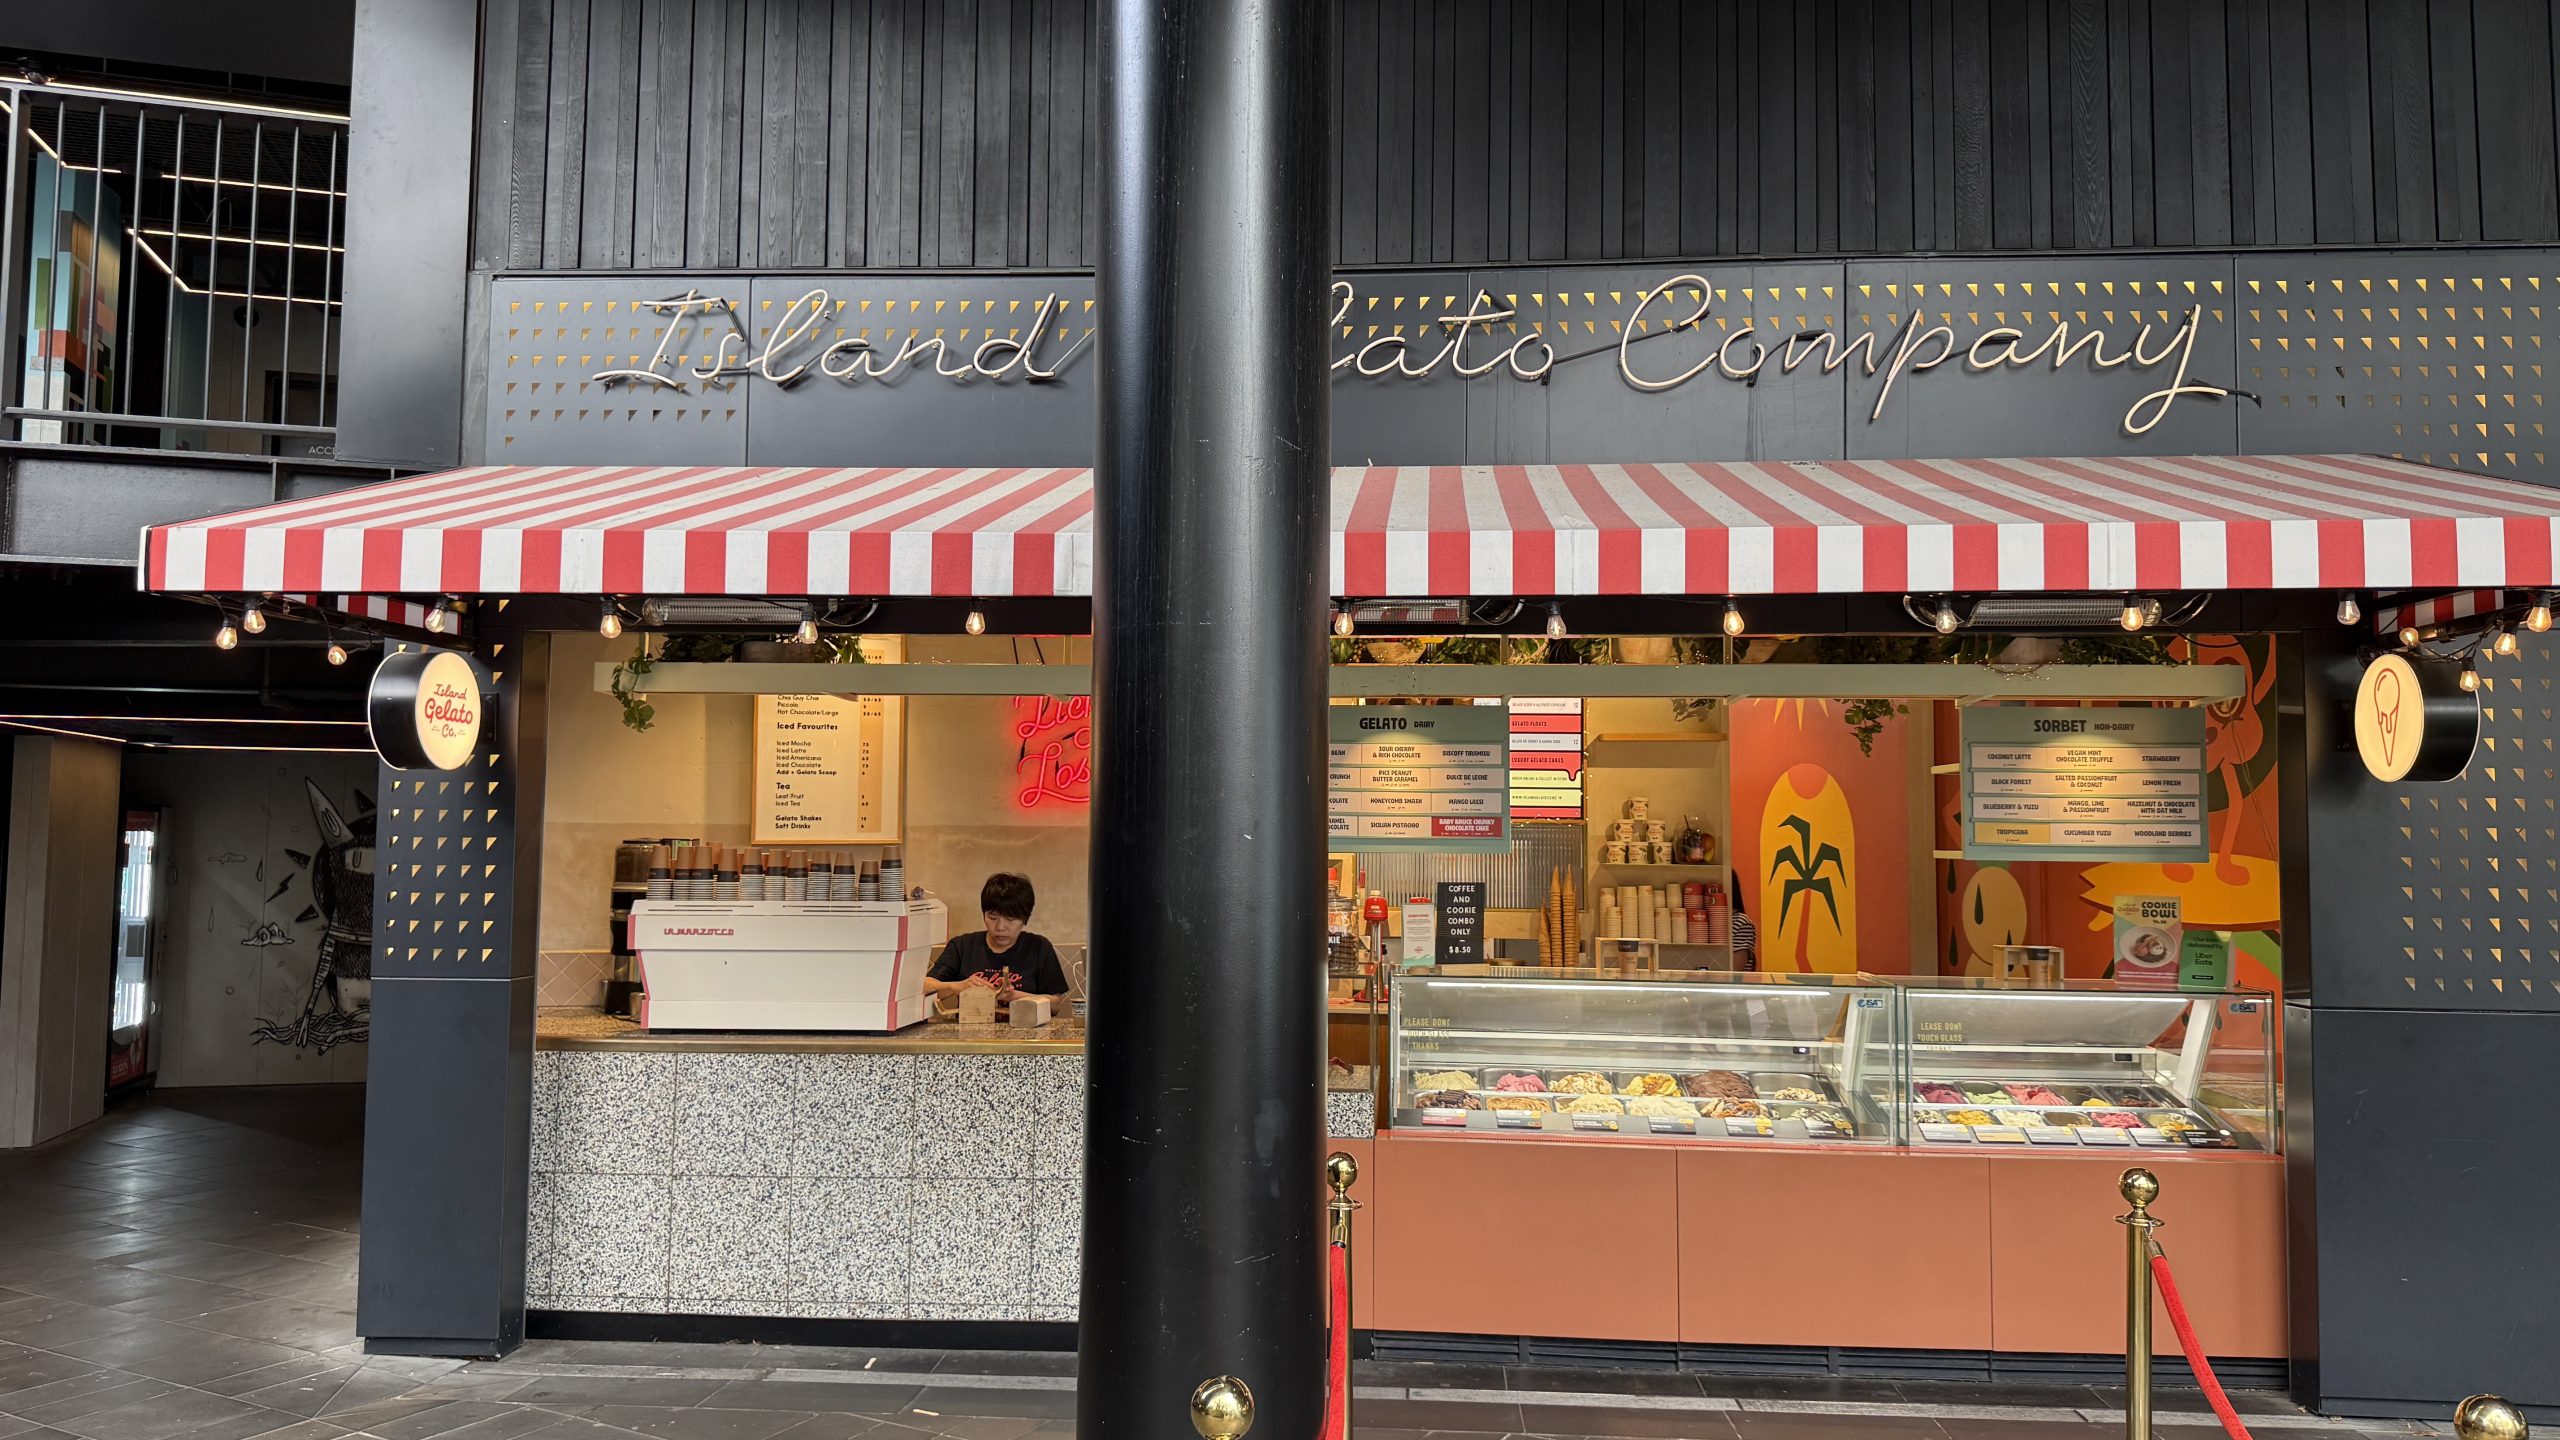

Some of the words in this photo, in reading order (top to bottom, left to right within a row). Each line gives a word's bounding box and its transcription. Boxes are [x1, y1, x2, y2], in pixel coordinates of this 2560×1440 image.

[594, 289, 1055, 388] Island
[1620, 275, 2227, 434] Company
[433, 684, 468, 700] Island
[425, 698, 473, 724] Gelato
[1360, 718, 1407, 729] GELATO
[2034, 720, 2086, 732] SORBET
[442, 724, 456, 738] Co.
[1018, 742, 1090, 806] Los
[2142, 910, 2177, 918] BOWL
[1404, 1018, 1429, 1026] PLEASE
[1412, 1042, 1439, 1050] THANKS
